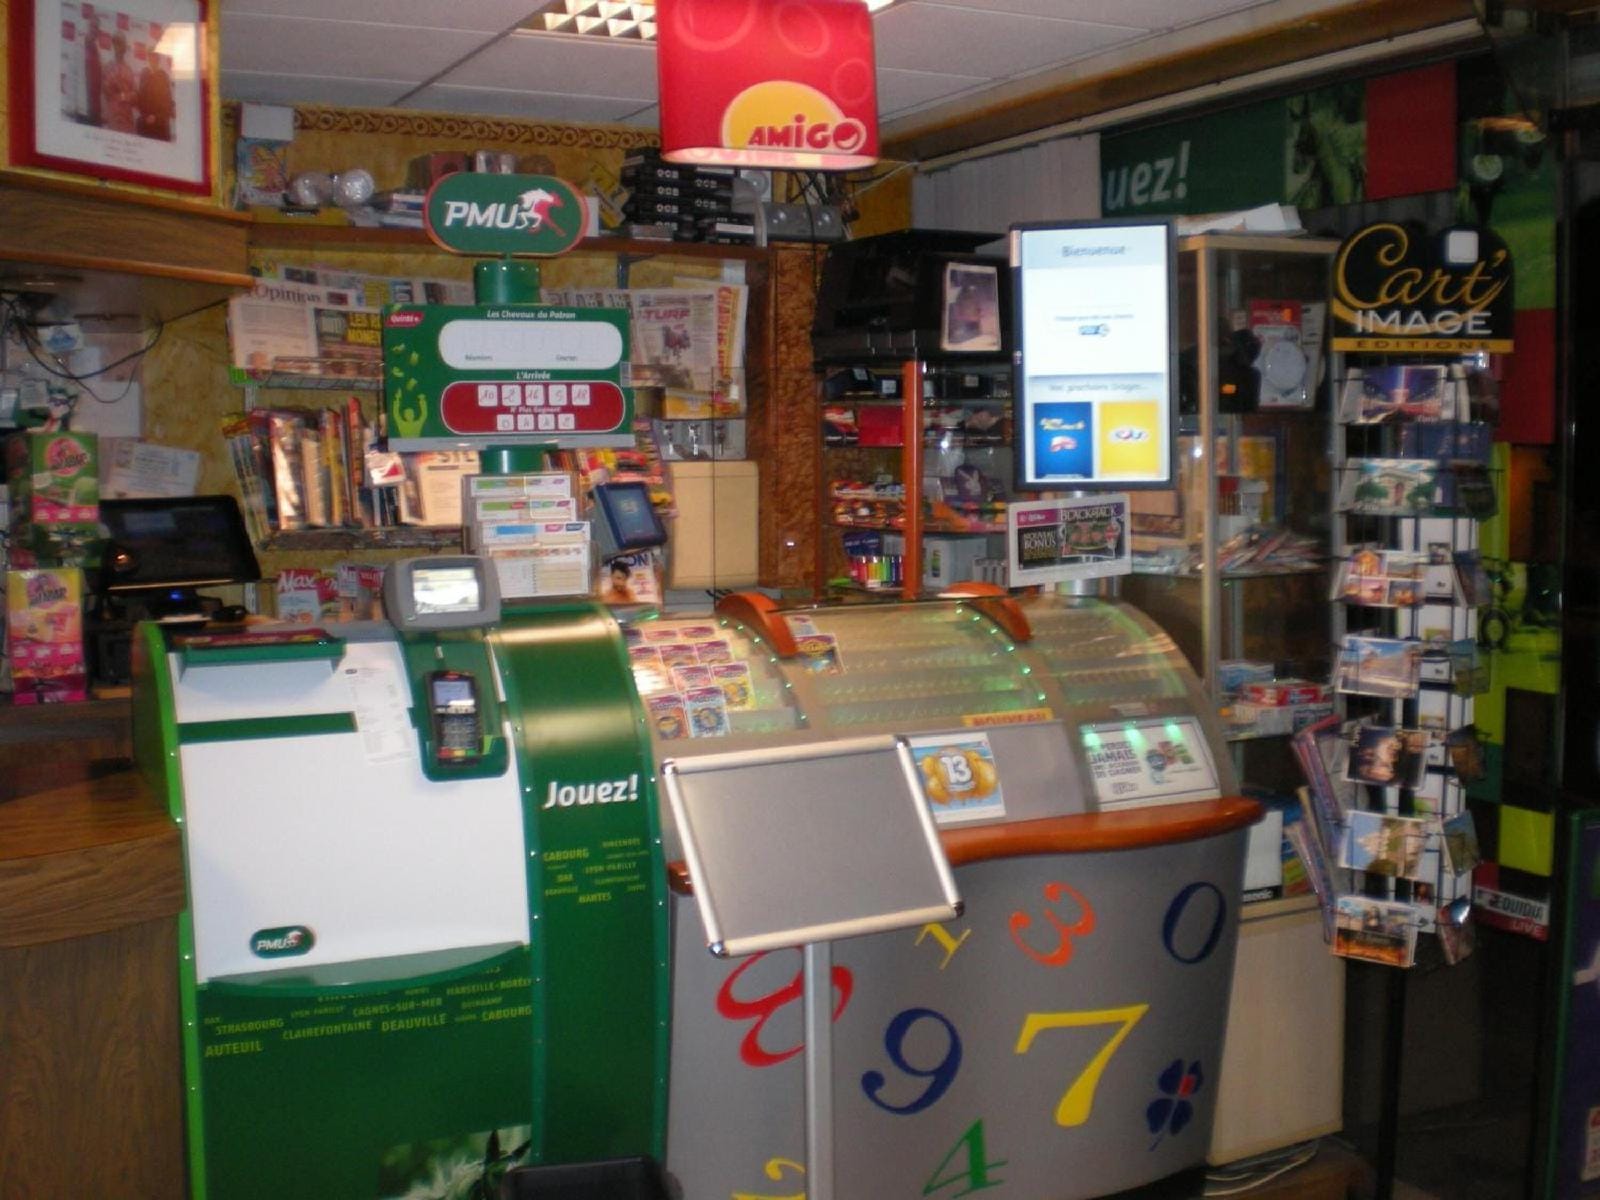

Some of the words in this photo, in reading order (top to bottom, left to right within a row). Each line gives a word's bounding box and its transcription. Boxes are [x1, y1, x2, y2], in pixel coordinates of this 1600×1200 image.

[444, 201, 518, 228] PMU
[1354, 309, 1493, 335] IMAGE
[941, 755, 972, 783] 13
[542, 774, 638, 810] Jouez!
[543, 848, 590, 862] CABOURG
[1009, 881, 1096, 967] 3
[1162, 881, 1227, 965] 0
[256, 938, 288, 951] PMU
[353, 997, 442, 1018] CAGNES-SUR-MER
[482, 1005, 532, 1022] CABOURG
[216, 1018, 284, 1036] STRASBOURG
[283, 1020, 372, 1040] CLAIREFONTAINE
[382, 1013, 447, 1032] DEAUVILLE
[205, 1040, 263, 1057] AUTEUIL
[861, 1008, 963, 1115] 9
[1016, 1003, 1150, 1127] 7
[922, 1118, 1009, 1199] 4
